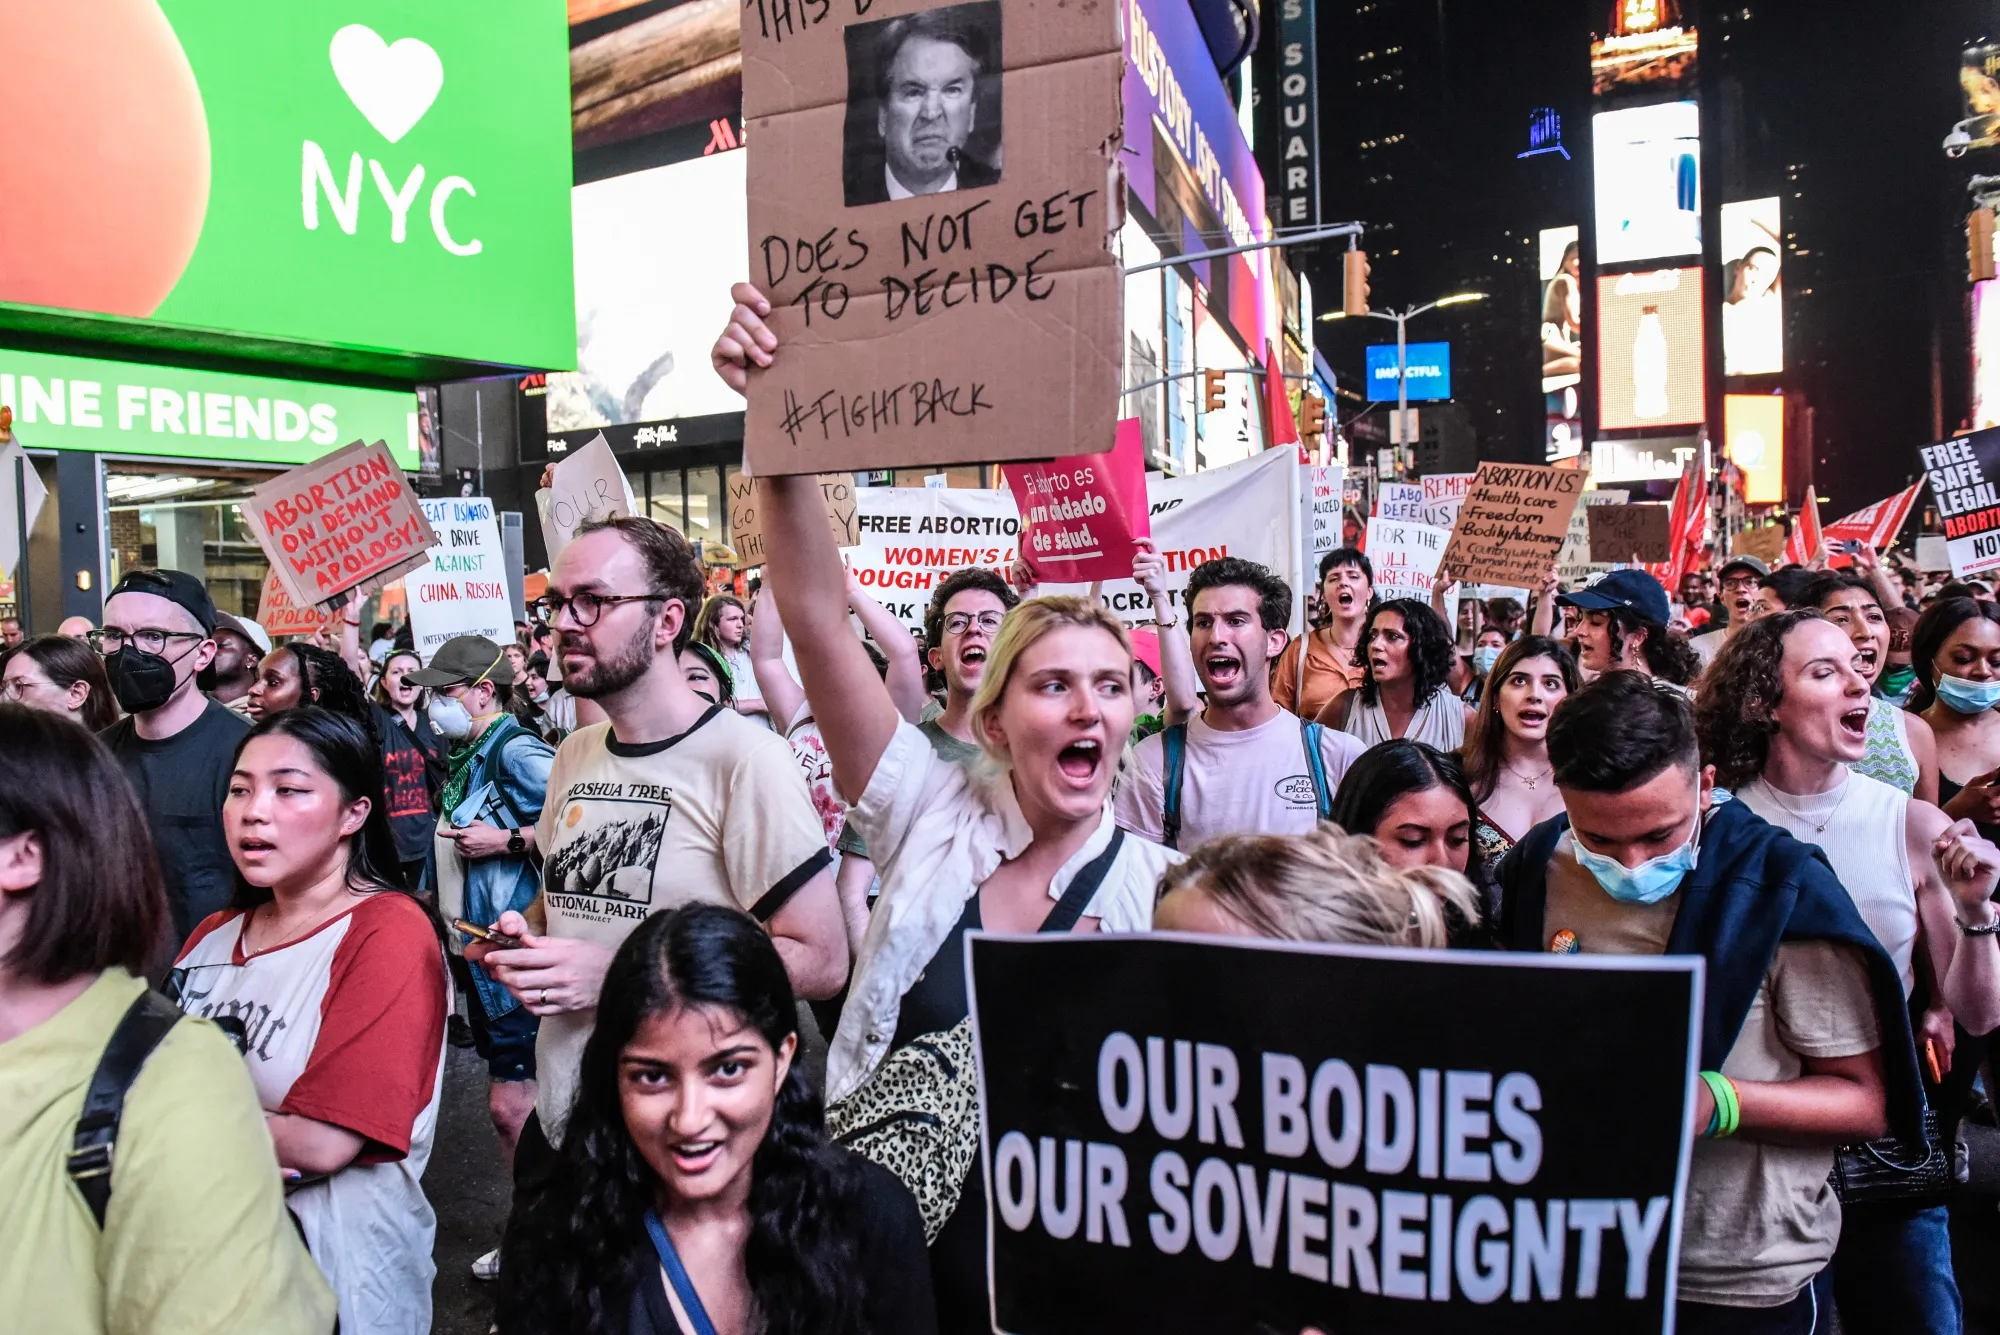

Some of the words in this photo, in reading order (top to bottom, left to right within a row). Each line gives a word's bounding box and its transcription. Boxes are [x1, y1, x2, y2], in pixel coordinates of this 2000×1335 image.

[1130, 2, 1192, 160] HISTORY
[1283, 43, 1309, 221] SQUARE
[301, 139, 483, 256] NYC
[762, 228, 868, 288] DOES
[901, 200, 990, 262] NOT
[1013, 189, 1098, 237] GET
[791, 278, 850, 327] TO
[884, 249, 1058, 320] DECIDE
[1375, 365, 1442, 380] IMPCTFUL
[117, 384, 338, 445] FRIENDS
[1920, 437, 1975, 470] FREE
[1074, 467, 1094, 486] es
[1473, 465, 1554, 491] ABORTION
[1928, 460, 1985, 493] SAFE
[263, 452, 391, 536] ABORTION
[820, 483, 848, 502] TO
[1524, 495, 1558, 509] care
[1935, 482, 2000, 517] LEGAL
[281, 521, 317, 553] ON
[321, 480, 402, 533] DEMAND
[732, 505, 755, 529] GO
[859, 515, 912, 534] FREE
[918, 516, 1022, 536] ABORTIO
[1031, 505, 1048, 525] un
[1470, 506, 1544, 524] Freedom
[289, 505, 393, 575] WITHOUT
[450, 529, 481, 547] DRIVE
[1033, 528, 1052, 552] de
[1376, 524, 1405, 544] FOR
[1416, 530, 1442, 550] THE
[1451, 540, 1461, 550] A
[1973, 534, 2000, 558] NO
[316, 513, 425, 592] APOLOGY!
[435, 554, 485, 572] AGAINST
[884, 547, 999, 567] WOMEN'S
[1444, 551, 1465, 563] this
[1470, 552, 1508, 566] human
[1510, 560, 1538, 571] right
[1443, 562, 1472, 577] NOT
[1473, 568, 1482, 577] a
[1507, 570, 1545, 585] countr
[420, 582, 463, 603] CHINA,
[466, 581, 504, 600] RUSSIA
[568, 782, 623, 797] JOSHUA
[628, 784, 673, 801] TREE
[581, 914, 612, 924] PROJECT
[604, 903, 649, 920] PARK
[1097, 1030, 1245, 1150] OUR
[1261, 1051, 1544, 1186] BODIES
[993, 1129, 1132, 1249] OUR
[1147, 1150, 1671, 1304] SOVEREIGNTY
